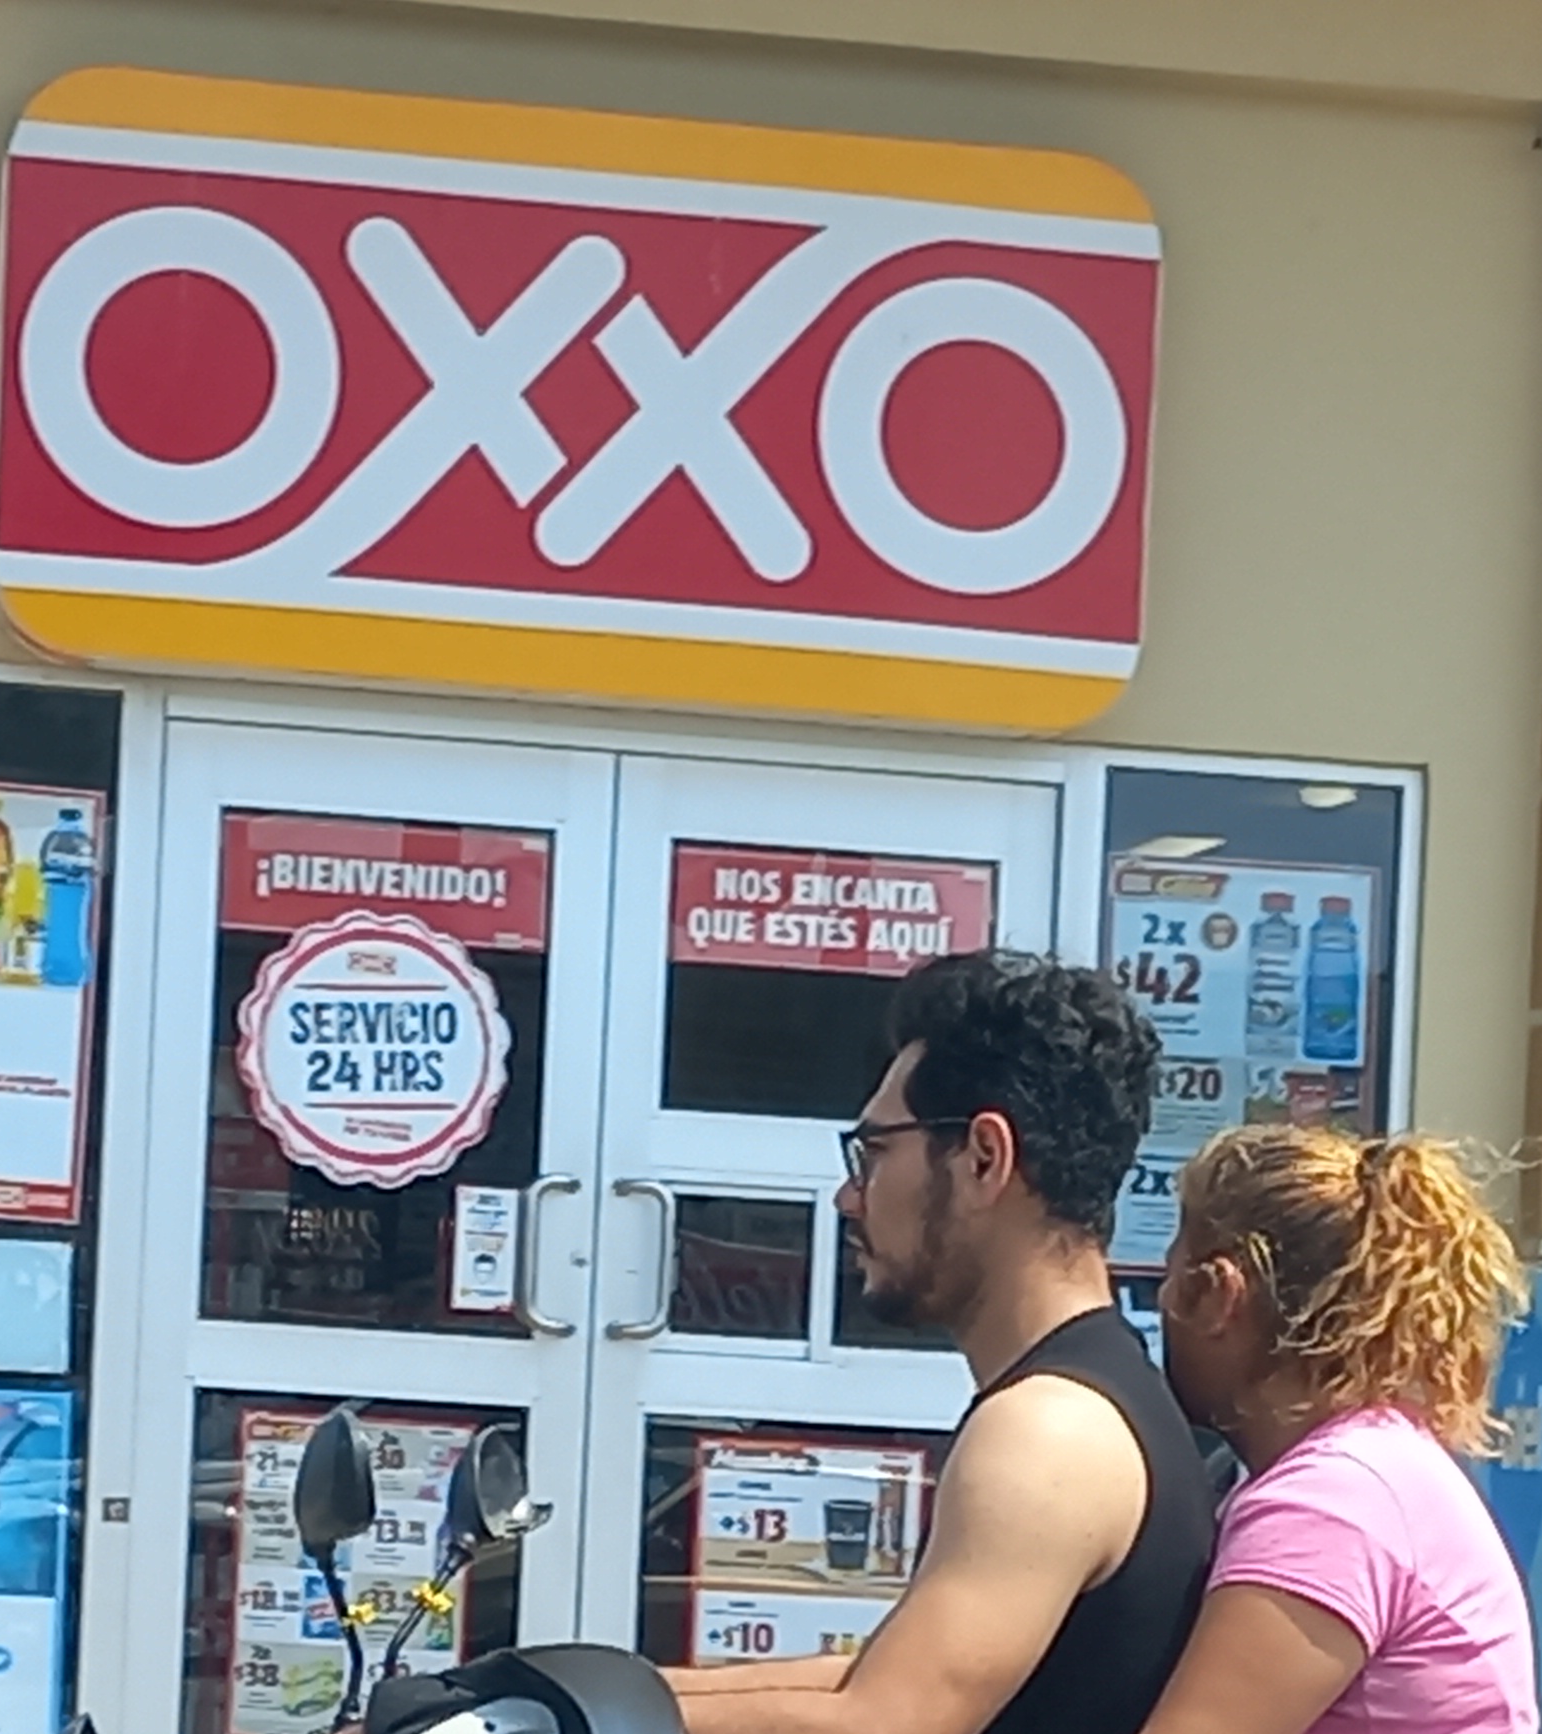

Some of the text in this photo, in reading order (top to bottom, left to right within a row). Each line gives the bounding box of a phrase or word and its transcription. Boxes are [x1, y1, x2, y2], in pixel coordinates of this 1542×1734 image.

[19, 203, 1128, 596] OXXO
[256, 853, 507, 908] ¡BIENVENIDO!
[715, 867, 938, 914] NOS ENCANTA
[688, 906, 953, 961] QUE ESTÉS AQUÍ
[1116, 951, 1201, 1005] $42
[289, 1000, 458, 1047] SERVICIO
[306, 1050, 444, 1093] 24 HRS
